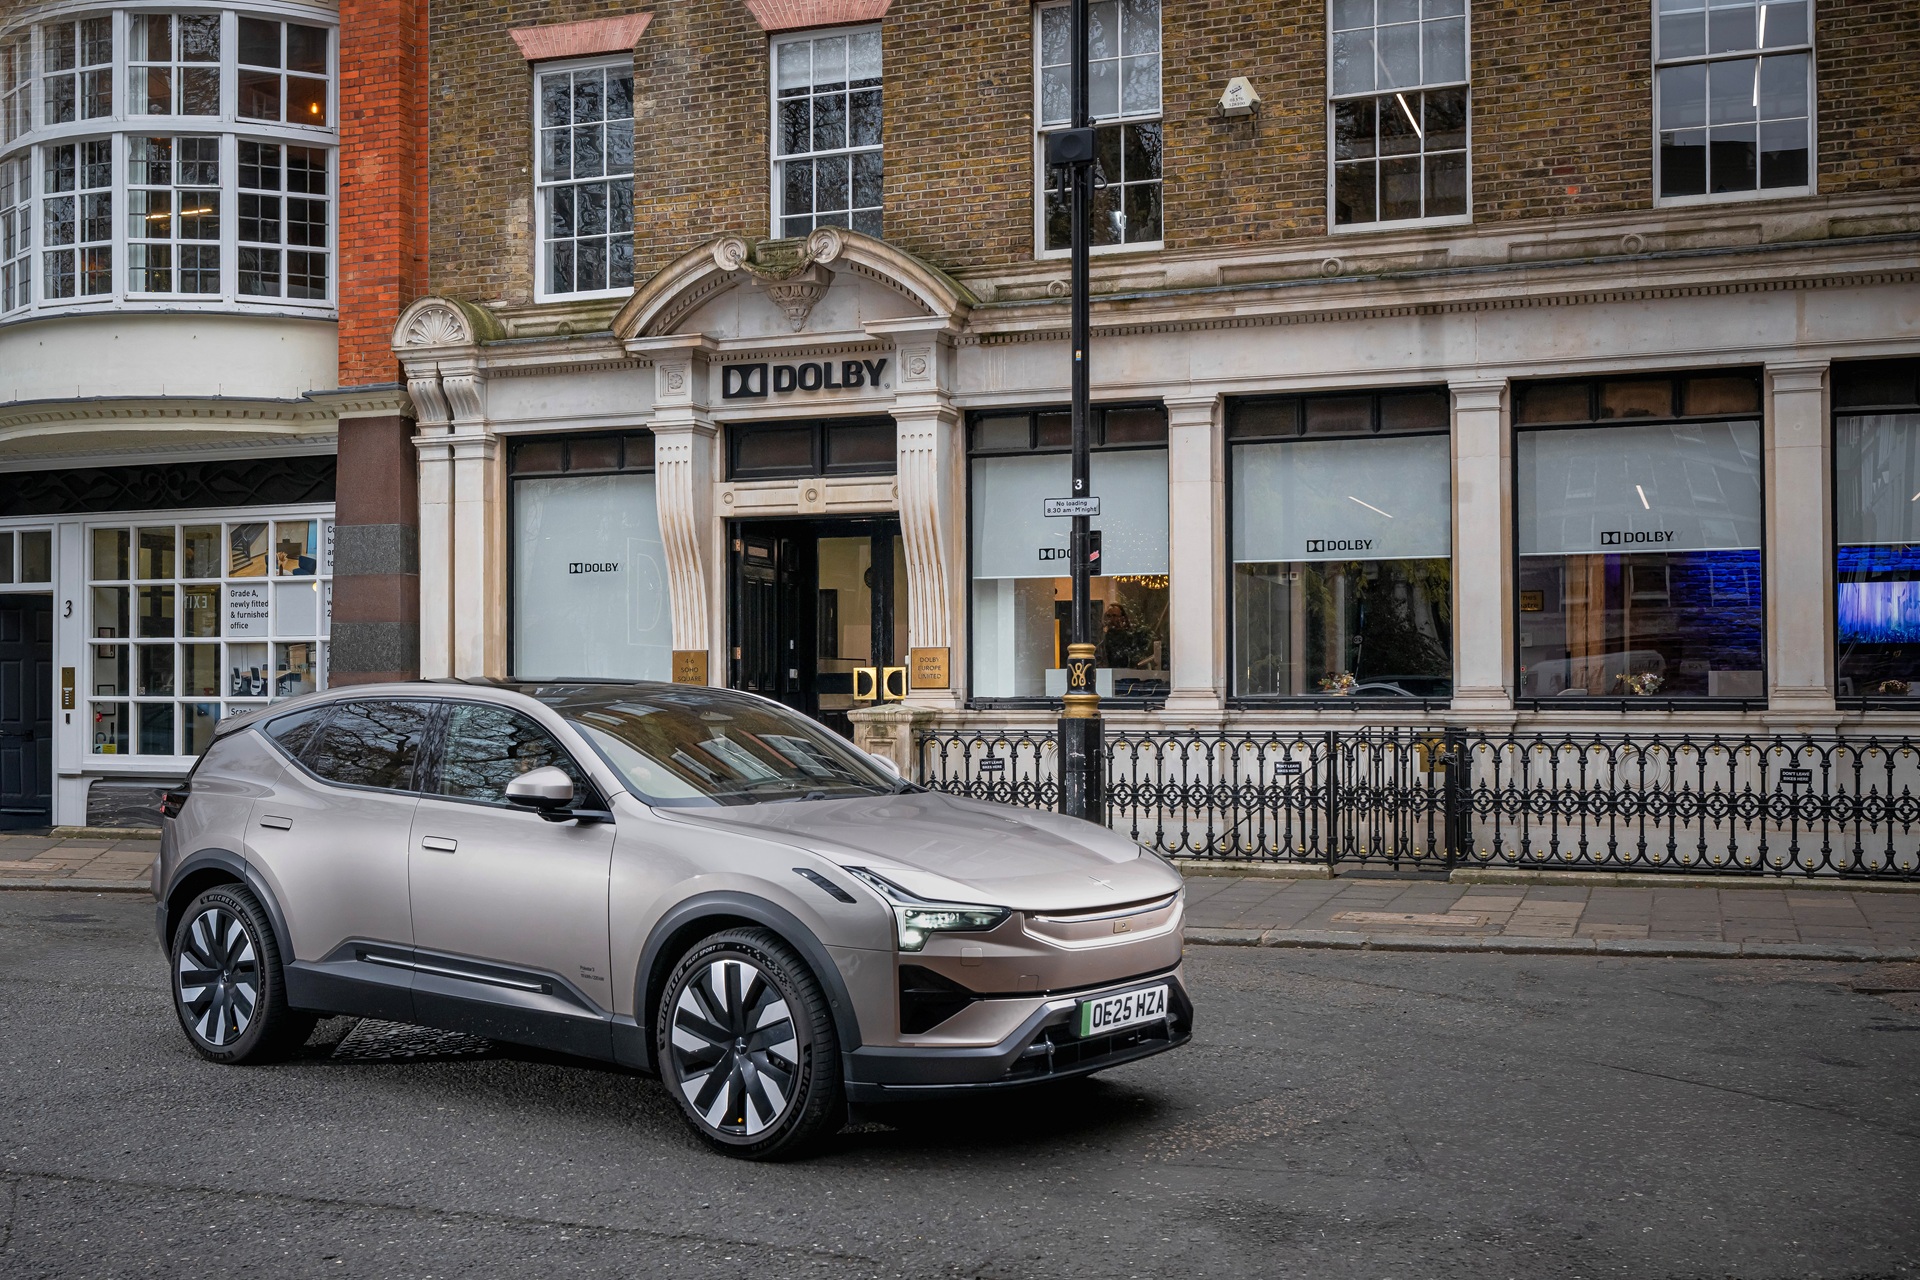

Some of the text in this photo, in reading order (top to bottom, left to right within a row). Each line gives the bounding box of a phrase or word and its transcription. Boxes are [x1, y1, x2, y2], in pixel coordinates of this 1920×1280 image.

[773, 358, 887, 392] DOLBY
[1074, 479, 1082, 490] 3
[1624, 531, 1674, 543] DOLBY
[1328, 540, 1372, 551] DOLBY
[584, 562, 618, 572] DOLBY
[64, 600, 73, 618] 3
[230, 600, 250, 609] newly
[208, 895, 241, 911] MICHELIN
[660, 967, 684, 1030] MICHELIN
[686, 954, 698, 967] PILOT
[700, 945, 716, 956] SPORT
[1093, 990, 1164, 1028] OE25 HZA
